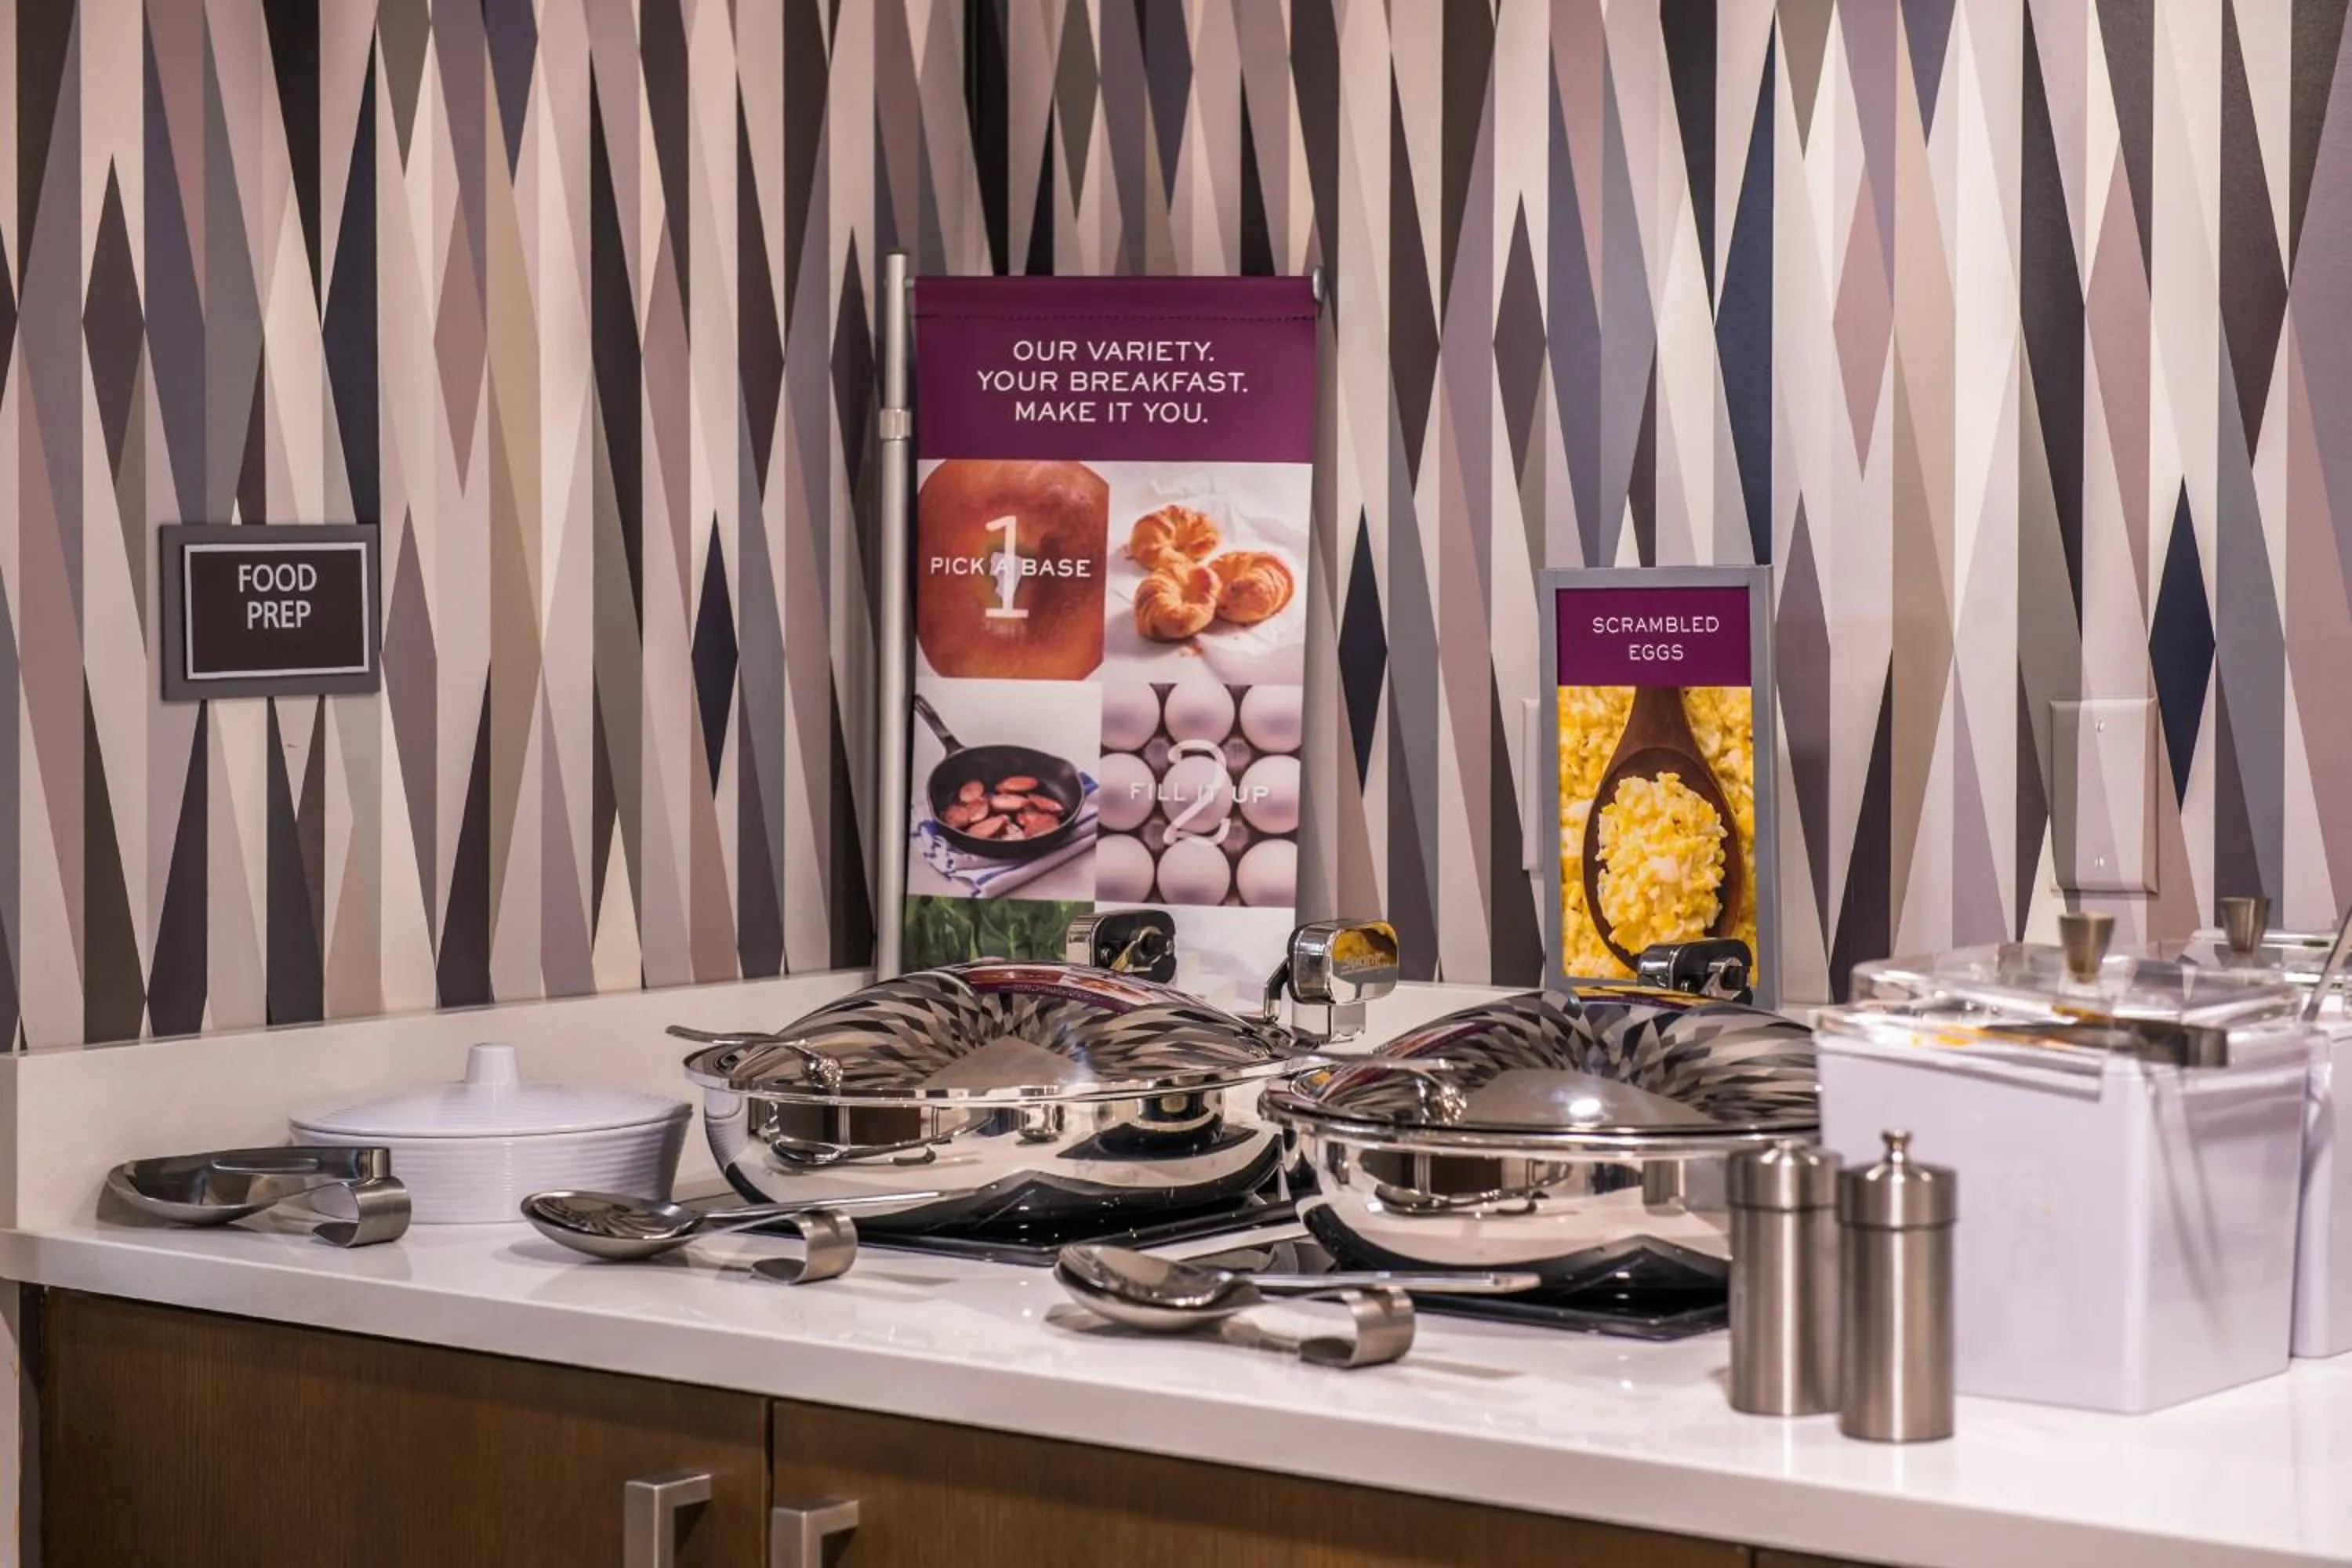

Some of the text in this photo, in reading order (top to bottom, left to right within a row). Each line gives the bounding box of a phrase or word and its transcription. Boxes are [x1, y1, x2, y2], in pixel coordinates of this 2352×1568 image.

[1013, 340, 1214, 362] OUR VARIETY.
[978, 370, 1248, 393] YOUR BREAKFAST.
[1015, 401, 1208, 423] MAKE IT YOU.
[238, 564, 317, 592] FOOD
[931, 557, 985, 575] PICK
[1022, 559, 1091, 578] BASE
[985, 515, 1029, 619] 1
[247, 600, 311, 629] PREP
[1592, 616, 1719, 633] SCRAMBLED
[1628, 644, 1684, 661] EGGS
[1131, 782, 1186, 801] FILL
[1232, 786, 1269, 804] UP
[1163, 739, 1231, 845] 2
